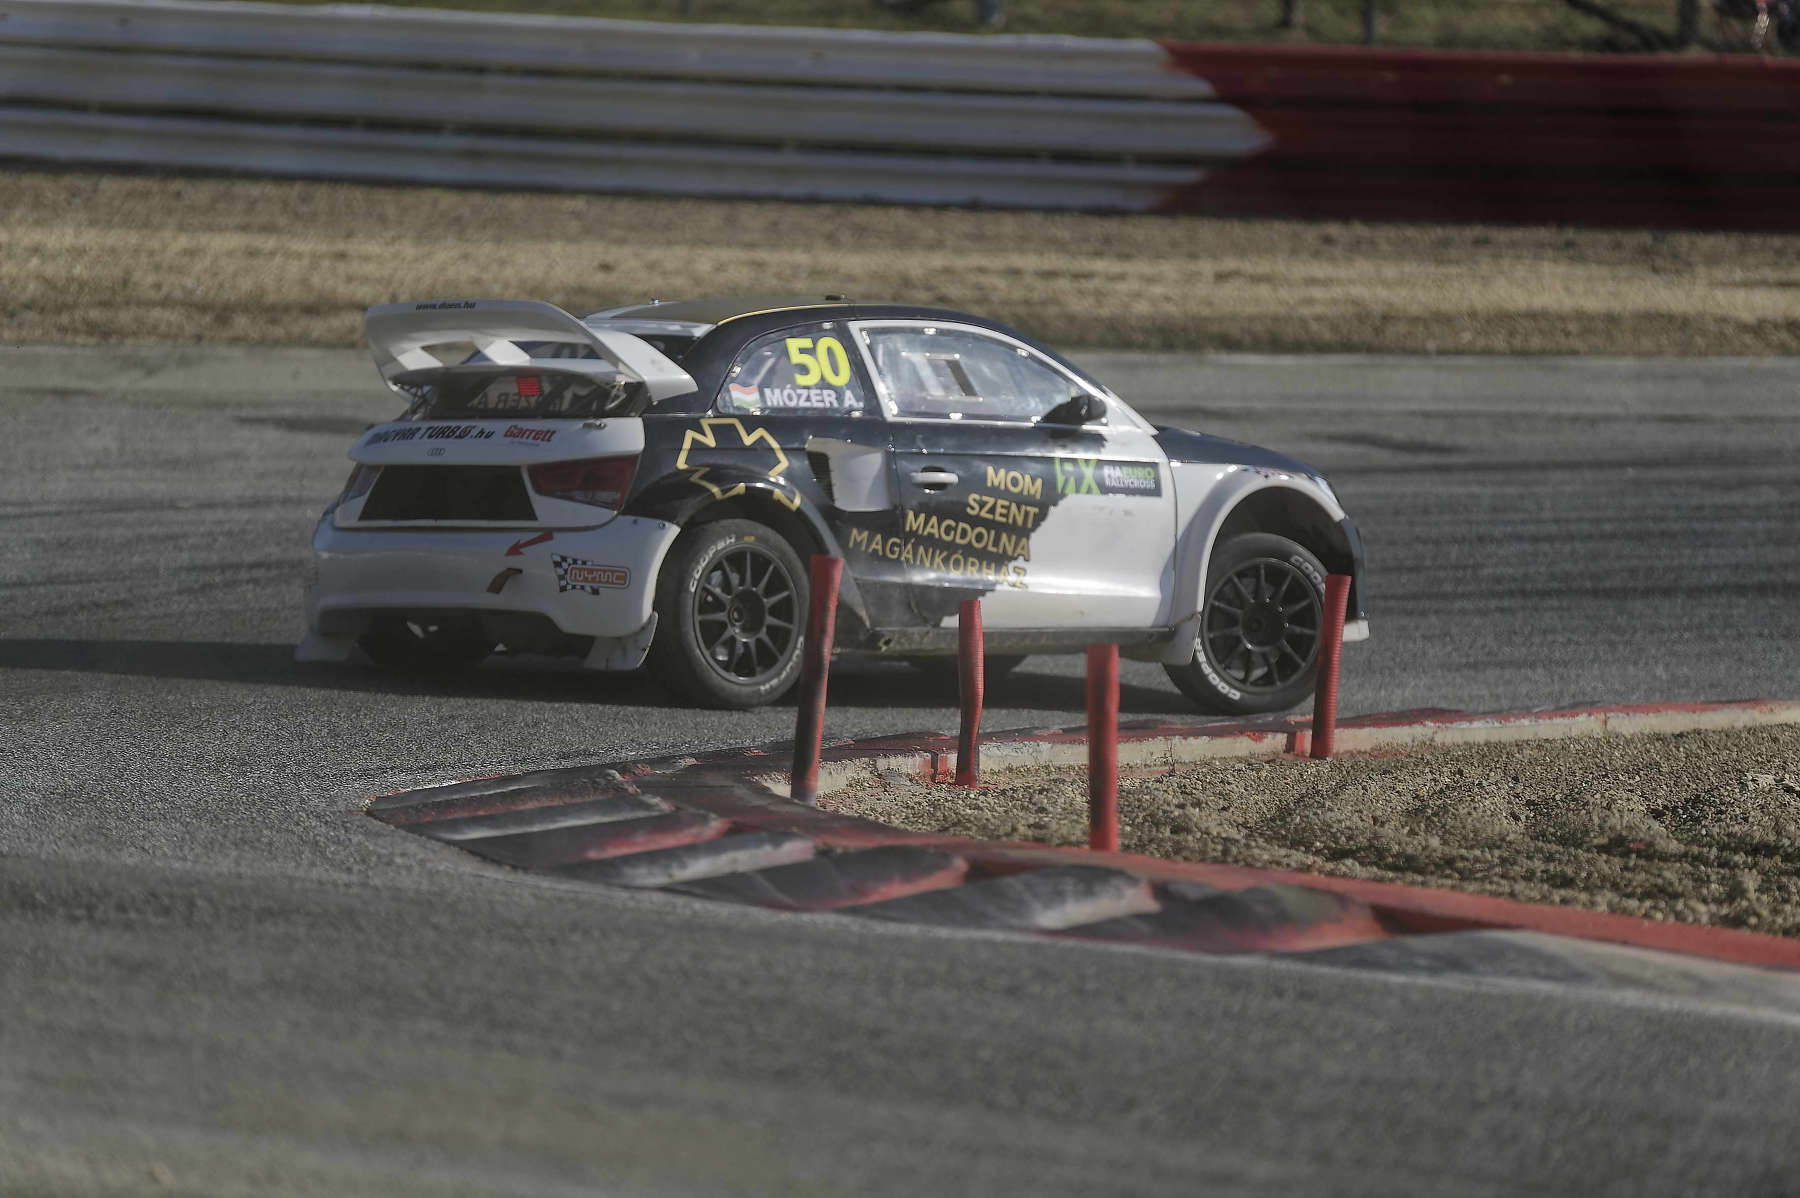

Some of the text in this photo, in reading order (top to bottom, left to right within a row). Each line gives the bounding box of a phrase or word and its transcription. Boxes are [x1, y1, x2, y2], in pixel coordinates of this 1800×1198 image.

[785, 336, 851, 387] 50
[763, 384, 839, 408] MÓZER
[503, 424, 557, 442] Garrett
[986, 465, 1043, 499] MOM
[966, 493, 1039, 529] SZENT
[905, 510, 1031, 562] MAGDOLNA
[1194, 637, 1242, 701] COOPER
